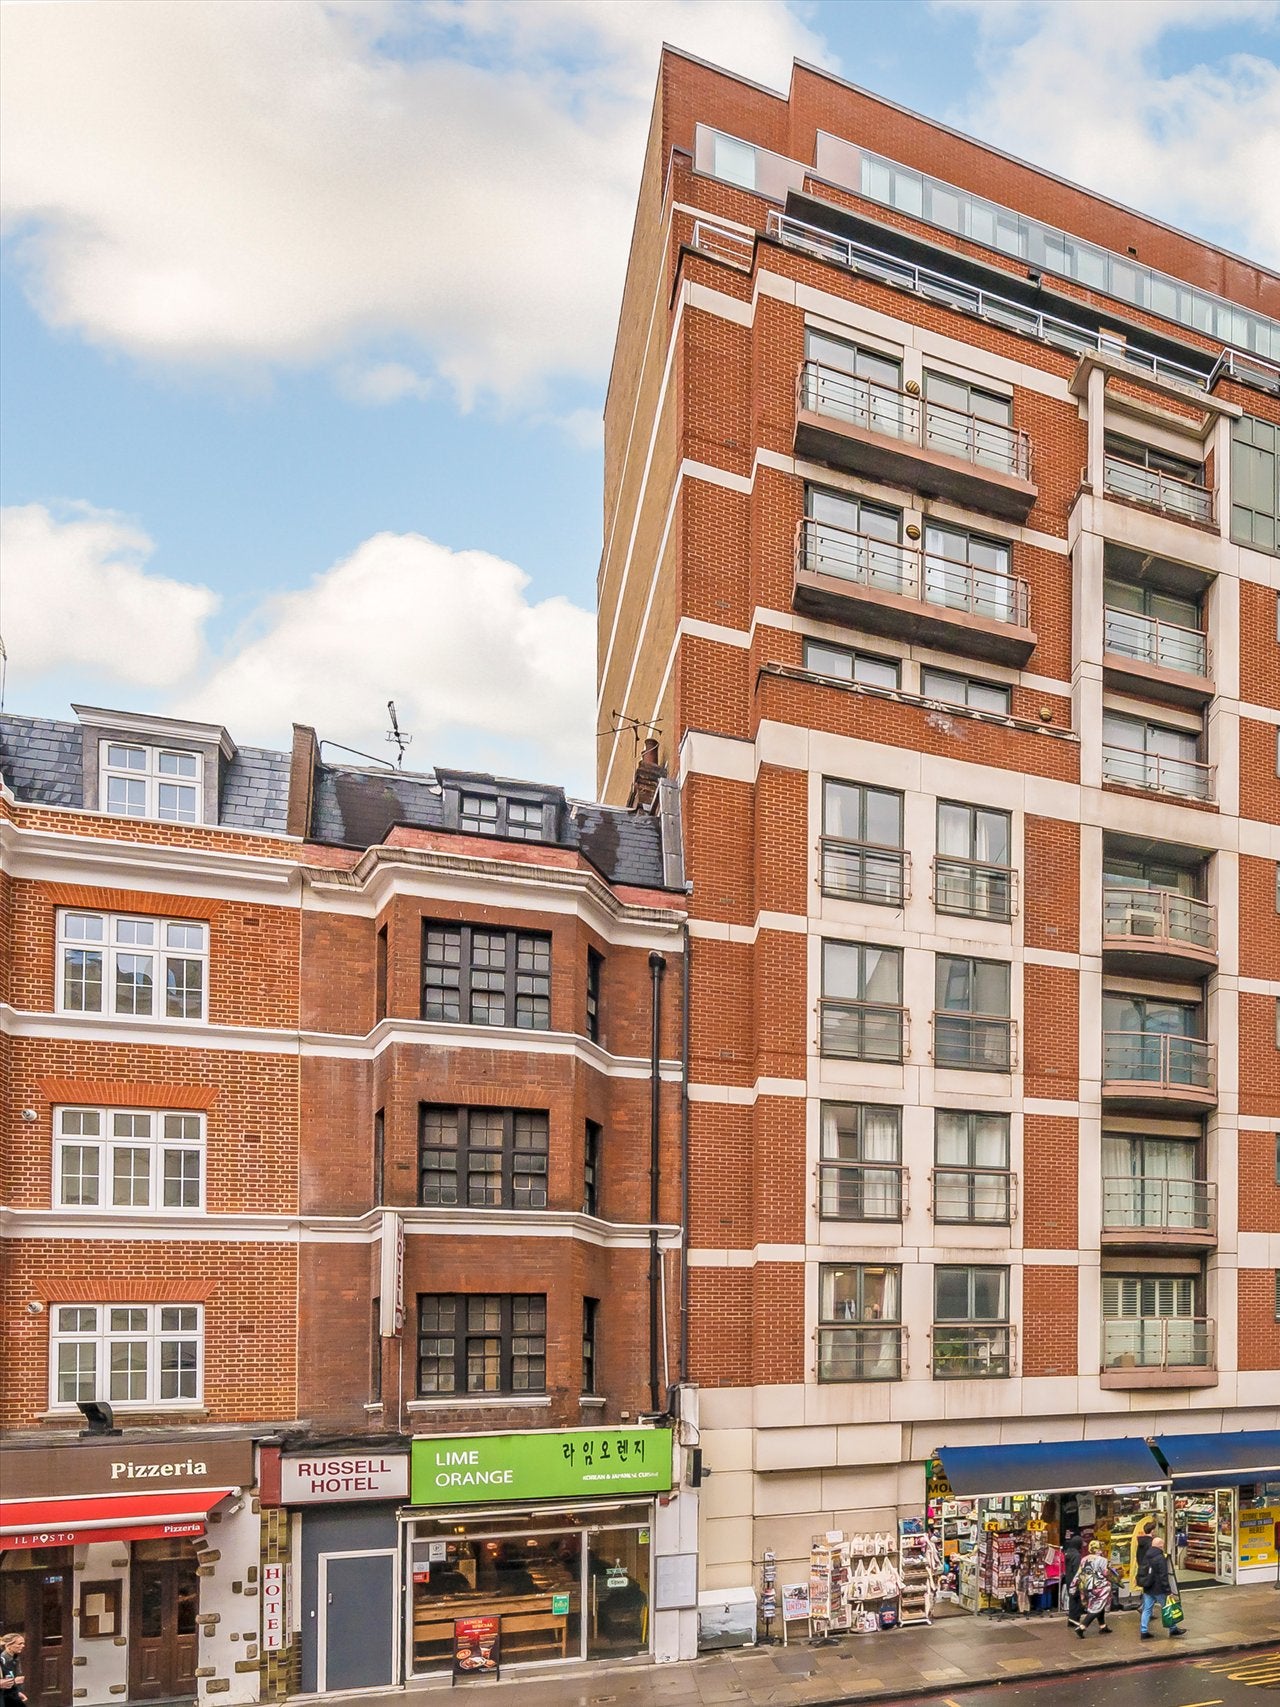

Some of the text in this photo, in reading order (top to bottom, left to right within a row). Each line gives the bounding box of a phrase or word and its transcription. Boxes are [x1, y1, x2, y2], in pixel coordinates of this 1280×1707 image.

[435, 1451, 479, 1466] LIME
[562, 1439, 645, 1467] 라임오렌지
[110, 1459, 207, 1479] Pizzeria
[298, 1459, 391, 1477] RUSSELL
[311, 1477, 379, 1493] HOTEL
[435, 1470, 513, 1487] ORANGE
[928, 1483, 952, 1494] MO
[164, 1524, 201, 1533] Pizzeria
[987, 1523, 999, 1531] £1
[1029, 1521, 1041, 1530] £1
[32, 1533, 75, 1544] POSTO
[265, 1568, 280, 1646] HOTEL
